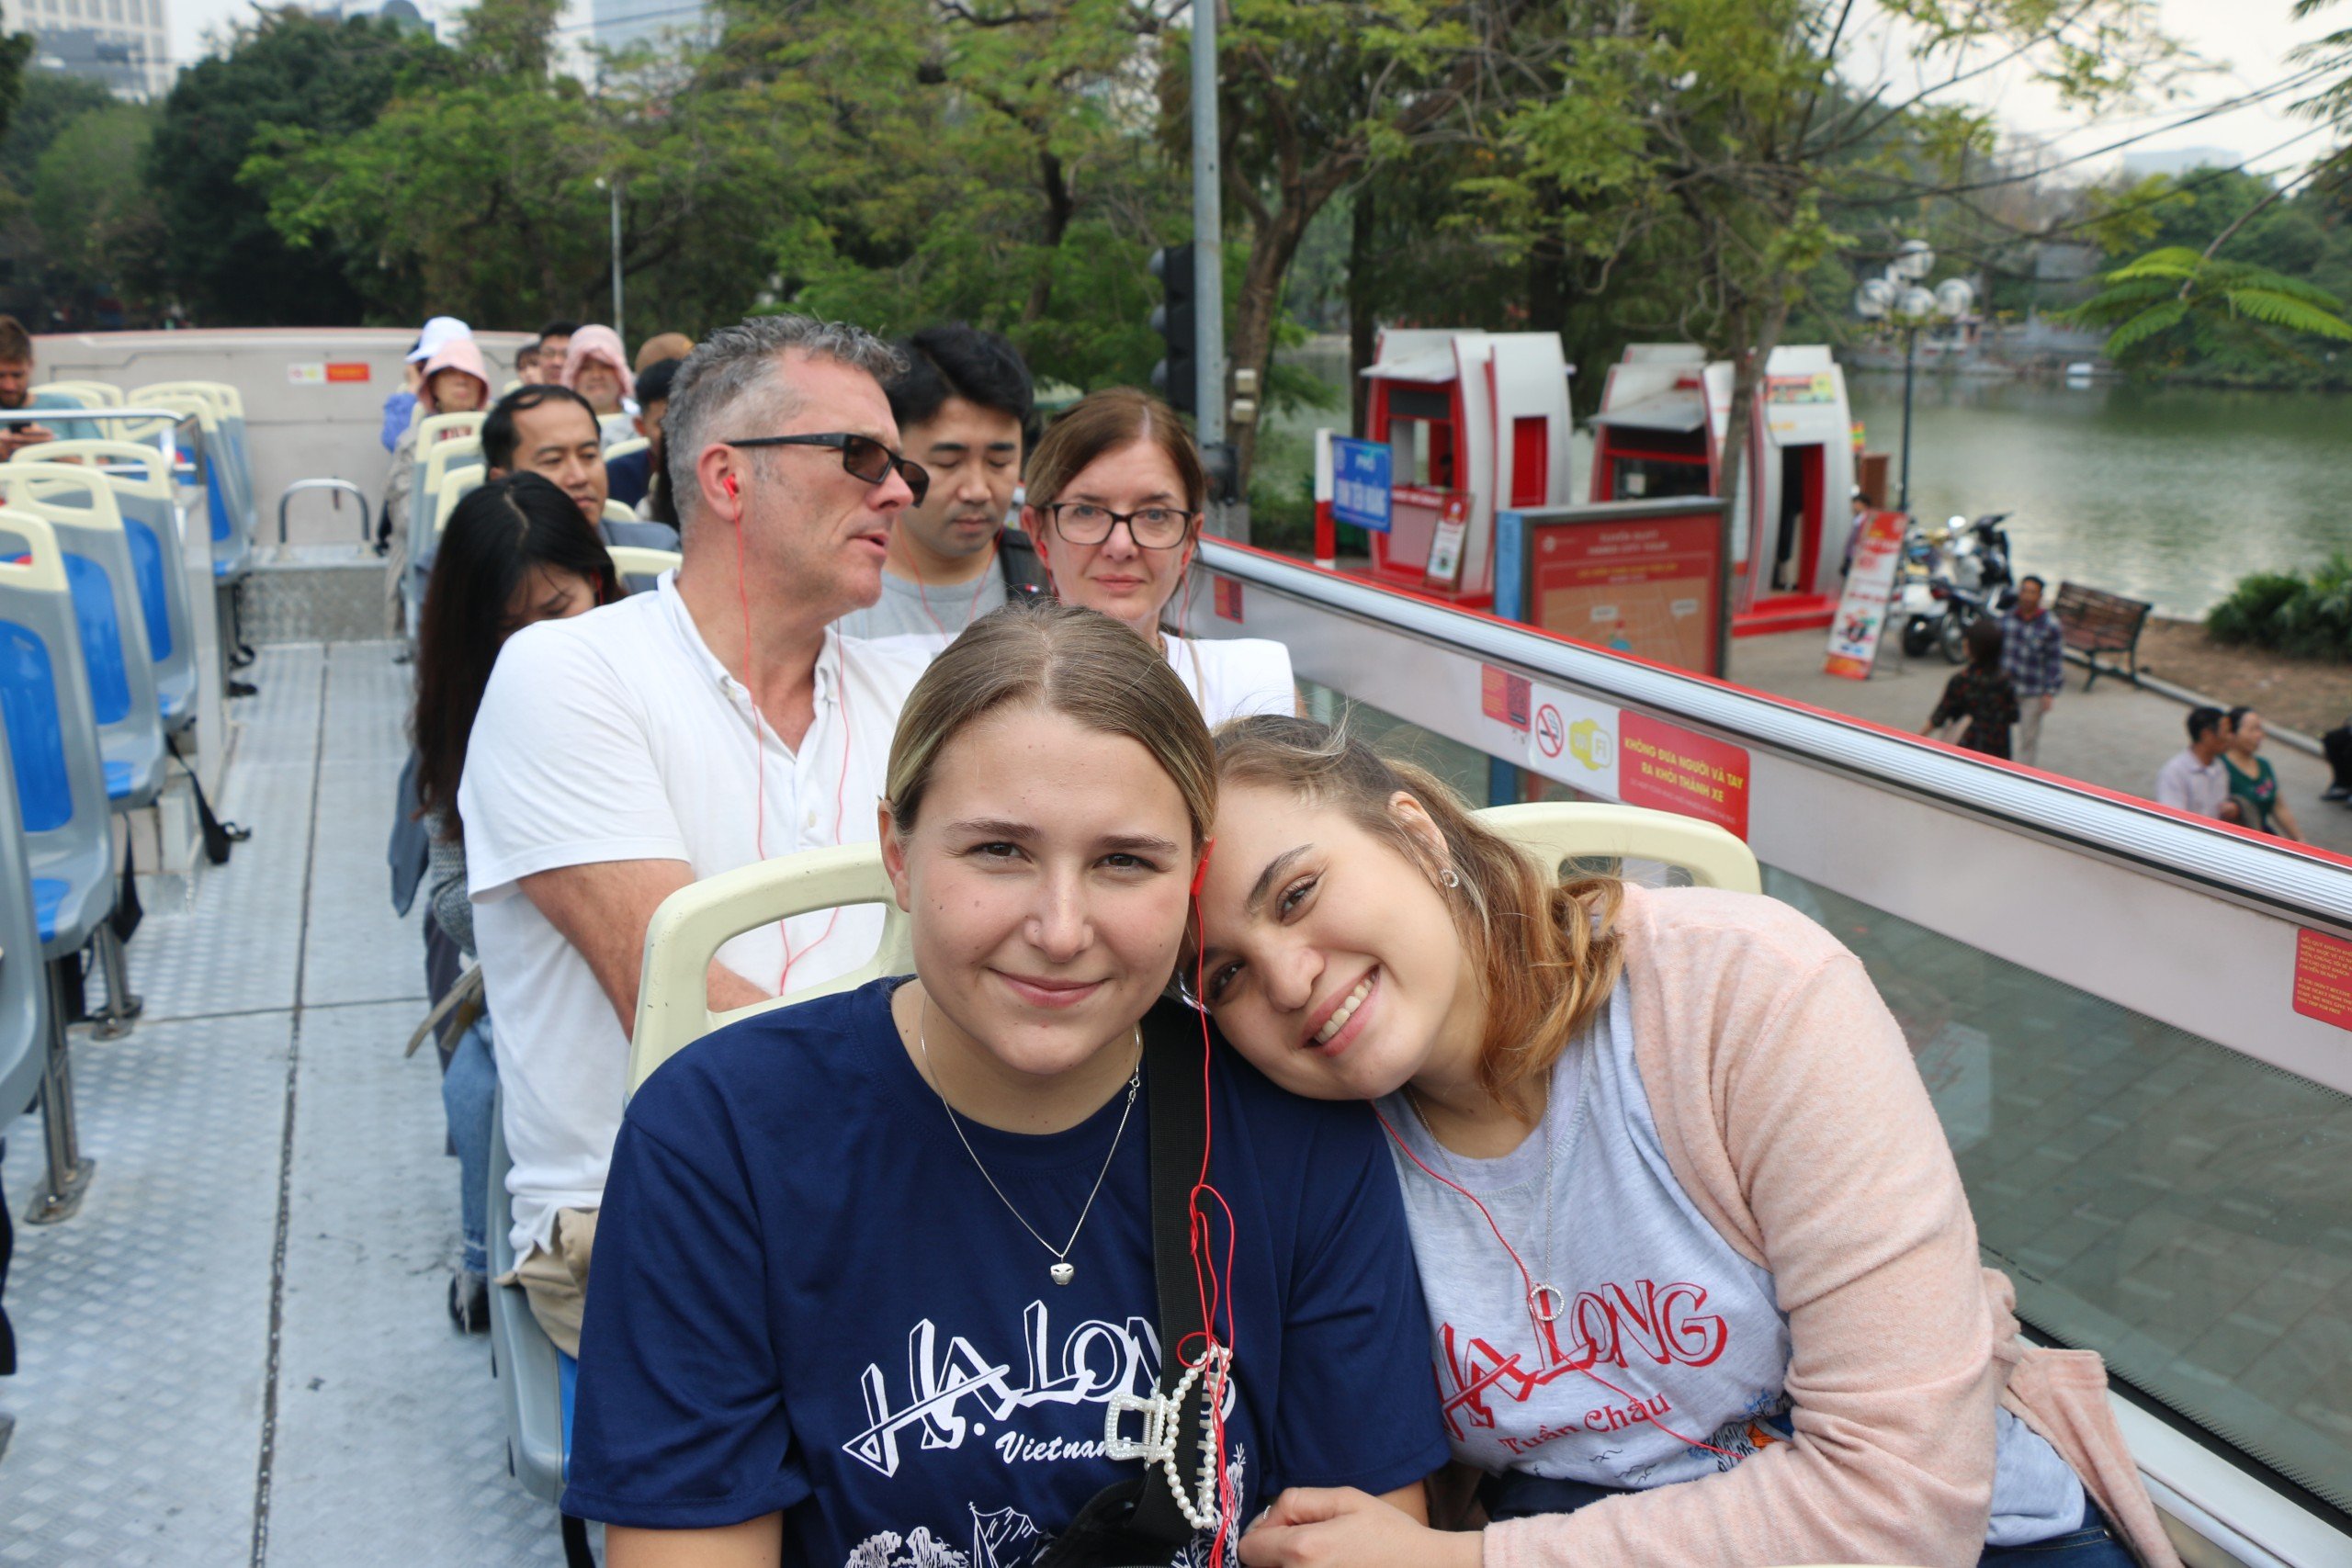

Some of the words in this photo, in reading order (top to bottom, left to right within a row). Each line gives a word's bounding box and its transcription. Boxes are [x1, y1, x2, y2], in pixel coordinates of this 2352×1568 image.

[1624, 737, 1657, 758] KHÔNG
[1711, 766, 1724, 784] VÀ
[1725, 773, 1744, 790] TAY
[1641, 761, 1653, 776] RA
[1679, 776, 1710, 797] THÀNH
[1711, 788, 1724, 803] XE
[1527, 1279, 1727, 1385] LONG
[1014, 1300, 1236, 1424] LON
[1584, 1393, 1671, 1433] Châu
